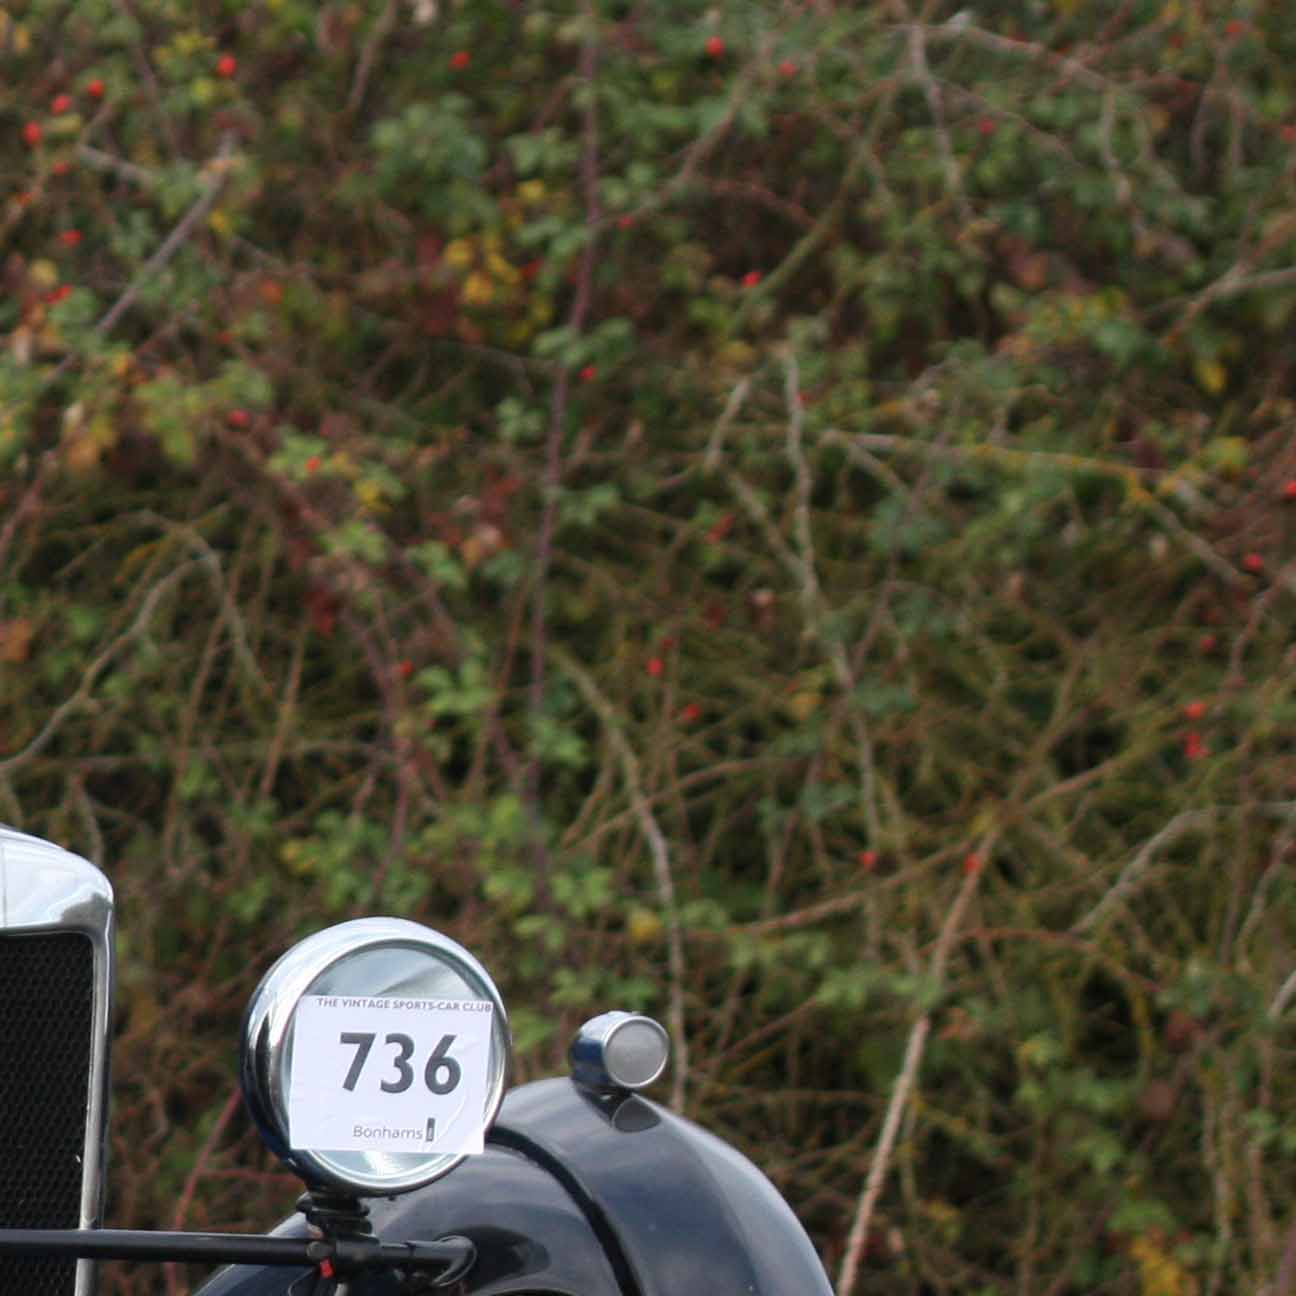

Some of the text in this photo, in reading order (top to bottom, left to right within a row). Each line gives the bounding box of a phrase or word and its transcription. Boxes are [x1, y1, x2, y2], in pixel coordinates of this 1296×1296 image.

[318, 998, 492, 1013] THE VINTAGE SPORTS-CAR CLUB
[339, 1031, 461, 1096] 736
[353, 1125, 424, 1140] Bonhams
